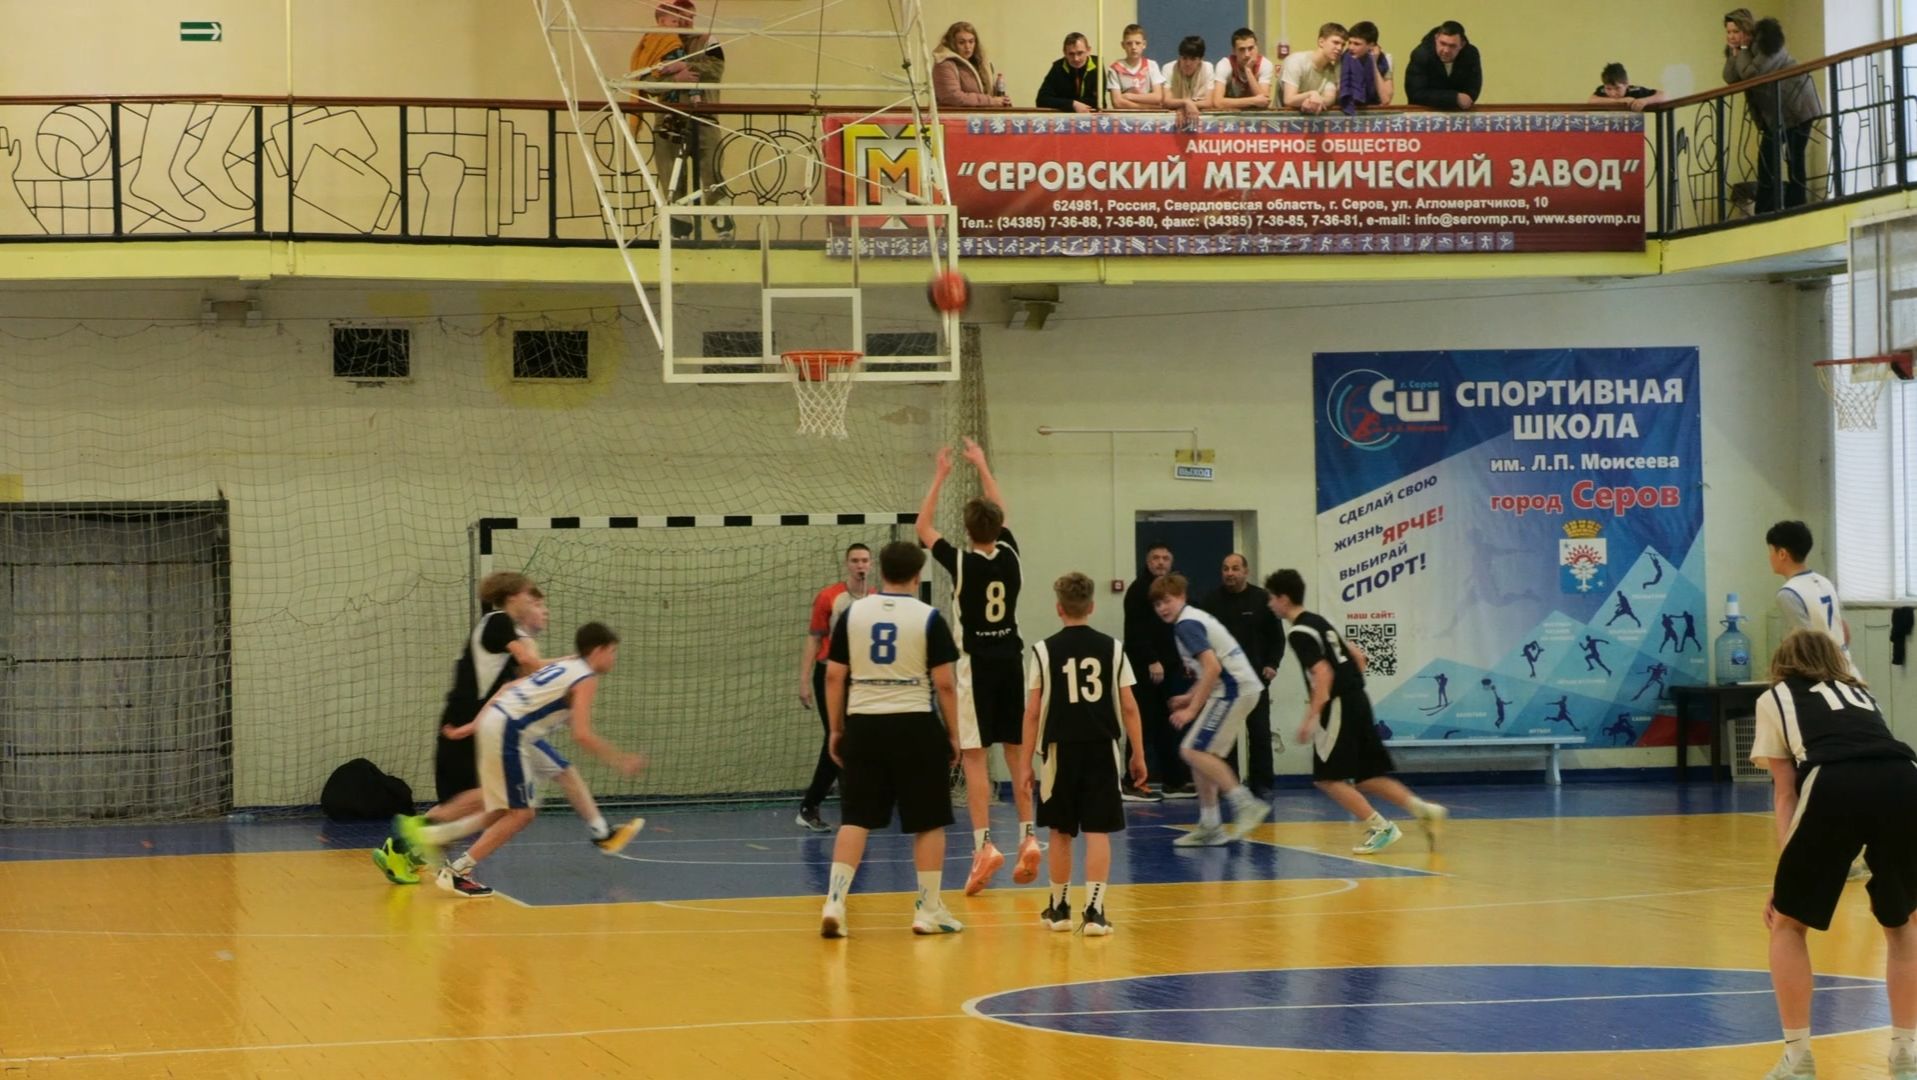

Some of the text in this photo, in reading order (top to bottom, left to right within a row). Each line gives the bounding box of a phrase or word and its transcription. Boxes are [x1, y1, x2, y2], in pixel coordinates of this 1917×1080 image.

[1186, 138, 1420, 155] АКЦИОНЕРНОЕ ОБЩЕСТВО
[1204, 154, 1492, 189] МЕХАНИЧЕСКИЙ
[960, 213, 1640, 230] Тел.: (34385) 7-36-88, 7-36-80, факс: (34385) 7-36-85, 7-36-81, e-mail: info@serovmp.ru, www.serovmp.ru
[1053, 197, 1548, 213] 624981, Россия, Свердловская область, г. Серов, ул. Агломератчиков, 10
[1456, 378, 1683, 408] СПОРТИВНАЯ
[1513, 413, 1639, 441] ШКОЛА
[1491, 453, 1680, 472] им. Л.П. Моисеева
[1339, 475, 1438, 525] СДЕЛАЙ СВОЮ
[1491, 480, 1680, 517] город Серов
[1334, 505, 1444, 552] ЖИЗНЬ ЯРЧЕ!
[1339, 541, 1408, 581] ВЫБИРАЙ
[1341, 552, 1427, 602] СПОРТ!
[985, 581, 1006, 623] 8
[1370, 611, 1395, 619] сайт:
[1820, 595, 1833, 630] 7
[870, 622, 897, 665] 8
[1062, 657, 1103, 703] 13
[1809, 680, 1876, 711] 10
